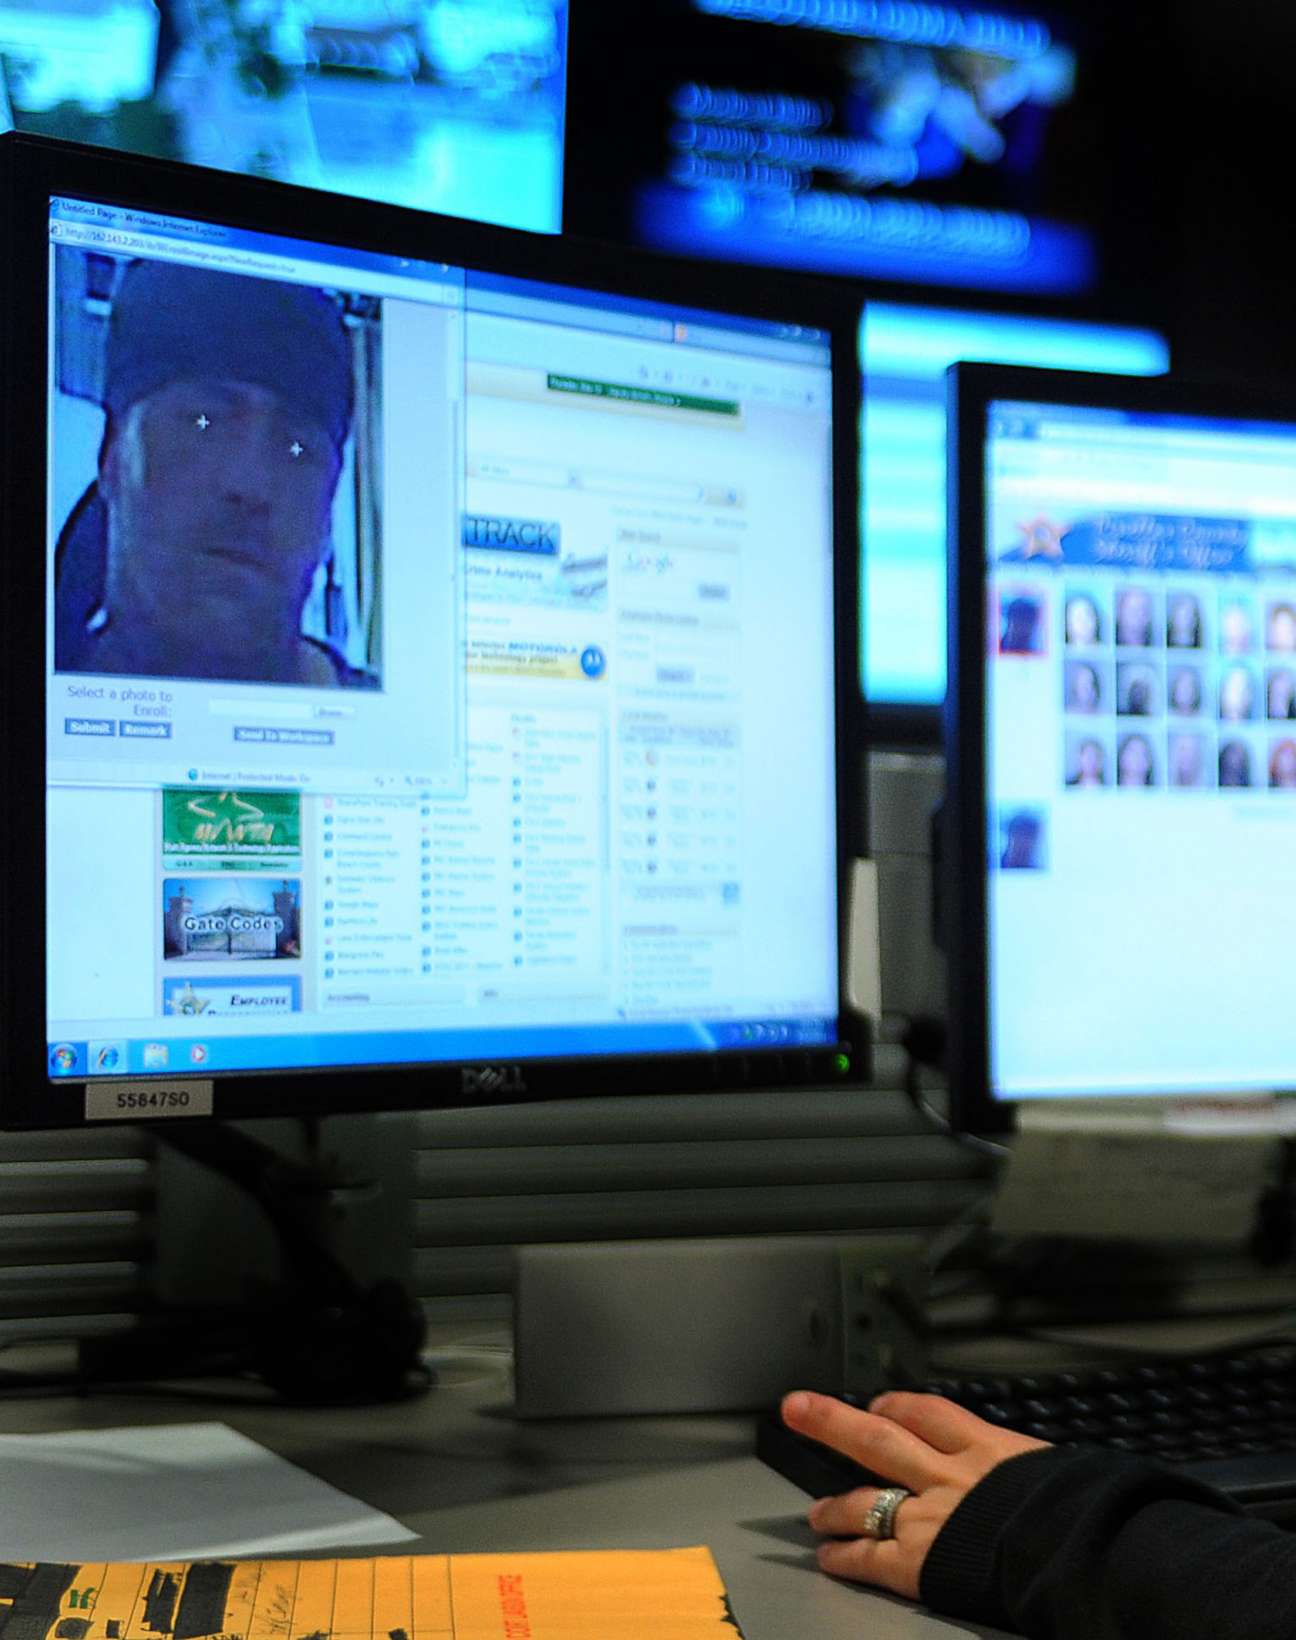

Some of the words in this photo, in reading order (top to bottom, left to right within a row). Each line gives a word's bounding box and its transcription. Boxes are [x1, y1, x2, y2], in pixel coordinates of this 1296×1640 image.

[469, 518, 555, 550] TRACK
[68, 685, 104, 699] Select
[110, 690, 117, 700] a
[120, 687, 157, 702] photo
[160, 690, 174, 702] to
[70, 720, 111, 733] Submit
[184, 916, 225, 931] Gate
[230, 916, 283, 931] Codes
